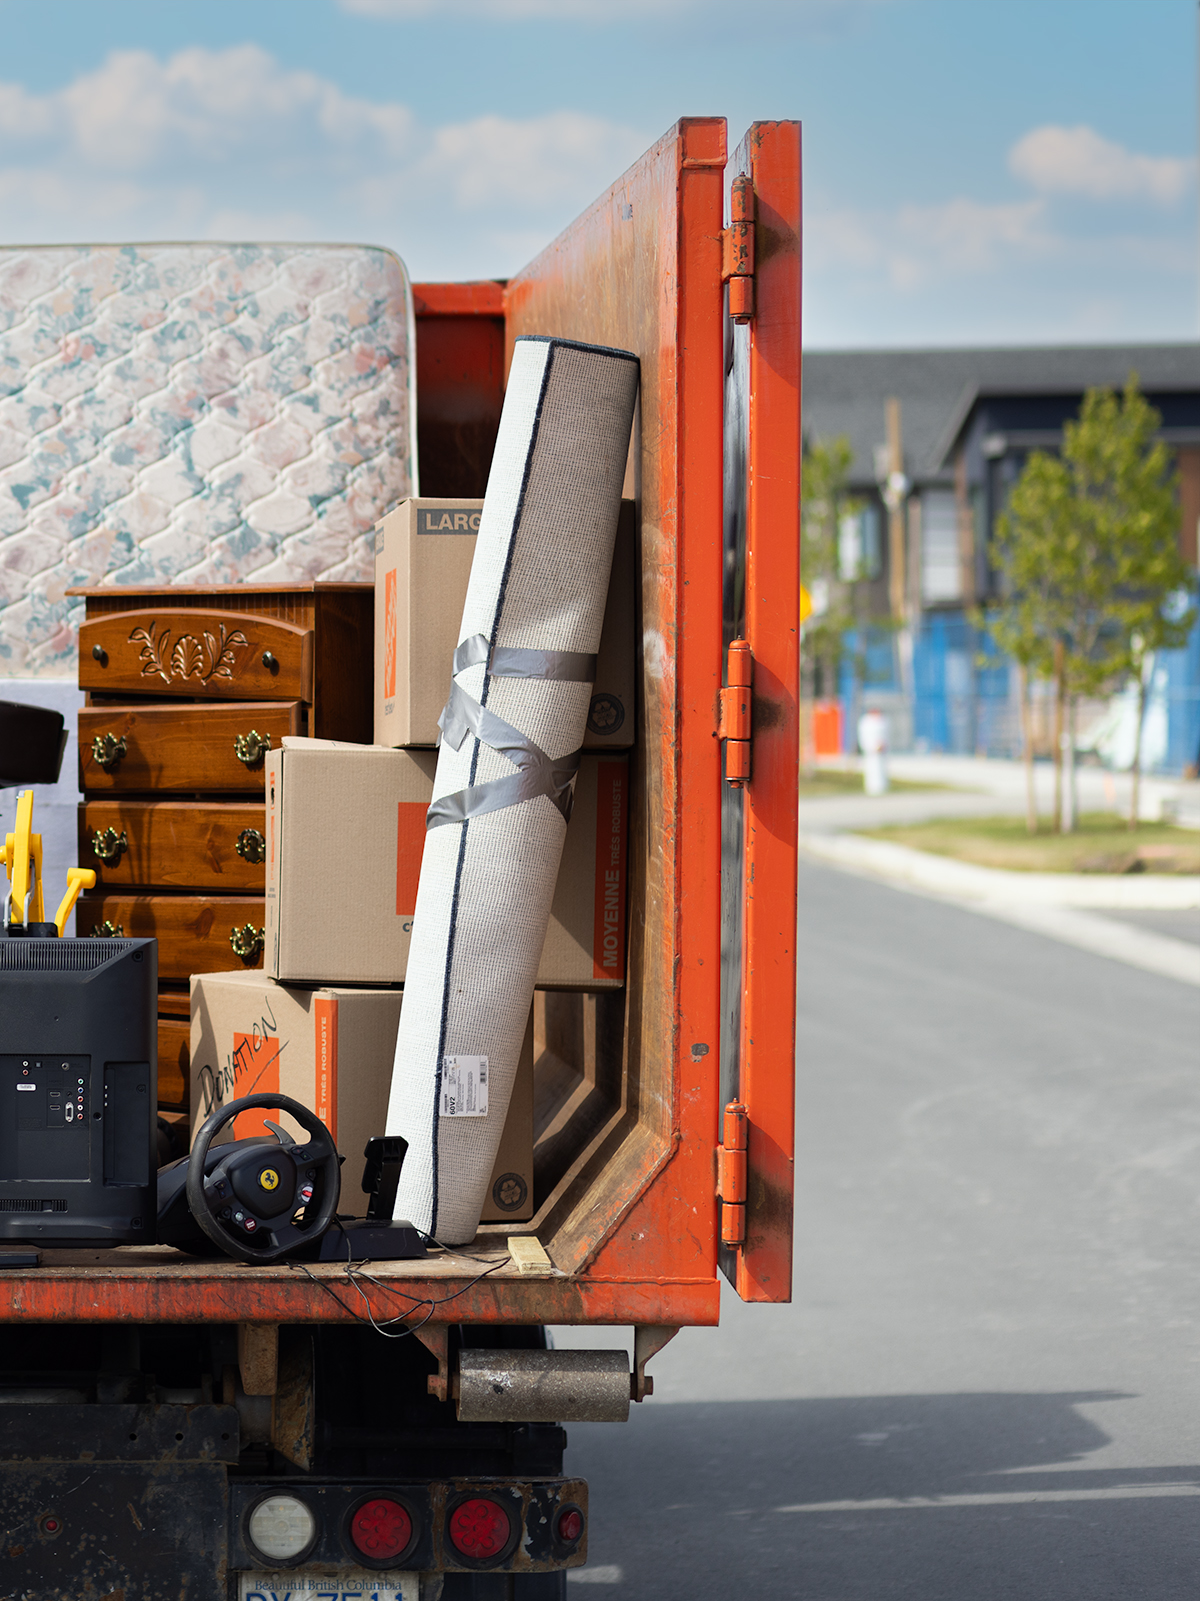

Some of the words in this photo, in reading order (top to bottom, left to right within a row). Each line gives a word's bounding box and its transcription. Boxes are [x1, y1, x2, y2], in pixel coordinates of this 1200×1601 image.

[425, 513, 482, 530] LARG
[611, 779, 622, 834] ROBUSTE
[603, 870, 620, 968] MOYENNE
[255, 1578, 305, 1591] Beautiful
[308, 1578, 344, 1591] British
[346, 1578, 402, 1591] Columbia
